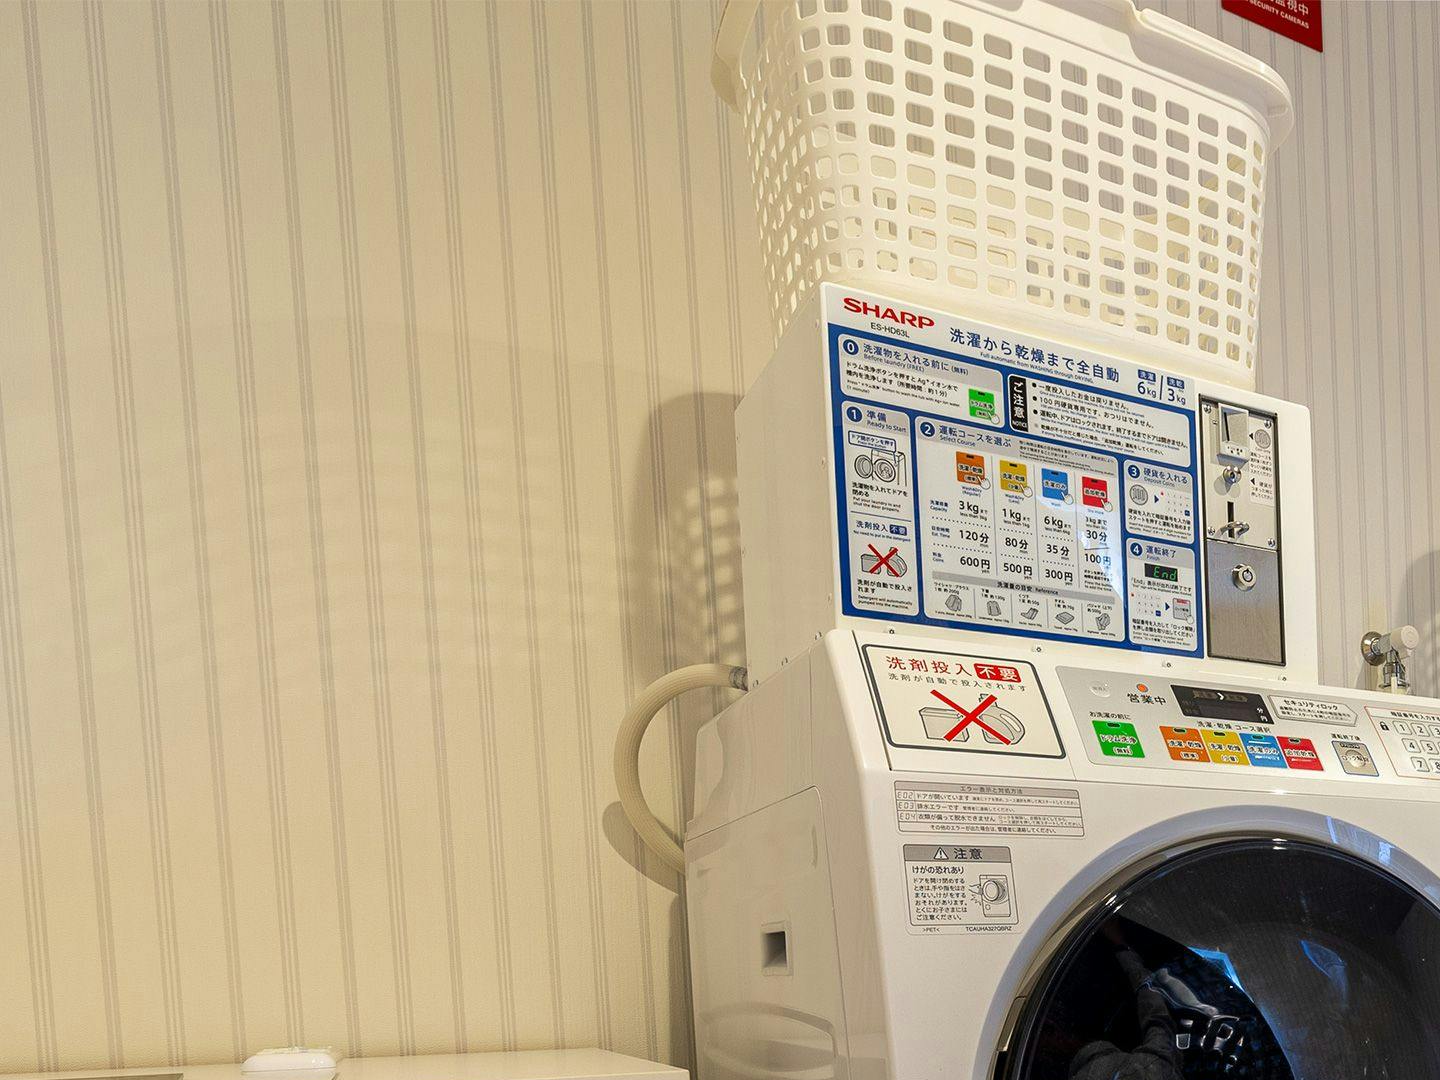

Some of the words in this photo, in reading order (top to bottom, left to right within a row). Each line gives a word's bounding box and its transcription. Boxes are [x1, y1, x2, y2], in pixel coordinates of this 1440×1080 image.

[1280, 11, 1309, 29] CAMERAS
[843, 297, 935, 329] SHARP
[870, 322, 910, 338] ES-HD63L
[863, 343, 950, 371] 洗濯物を入れる前に
[950, 327, 1119, 383] 洗濯から乾燥まで全自動
[1012, 381, 1025, 419] ご注意
[866, 409, 887, 422] 準備
[867, 421, 886, 431] Ready
[939, 424, 1012, 448] 運転コースを選ぶ
[940, 434, 957, 444] Select
[957, 438, 976, 448] Course
[1143, 467, 1188, 484] 硬貨を入れる
[856, 520, 888, 533] 洗剤投入
[959, 529, 989, 543] 120分
[1086, 530, 1107, 542] 30分
[1005, 537, 1029, 550] 80分
[1046, 544, 1070, 556] 35分
[1146, 545, 1176, 558] 運転終了
[960, 556, 990, 570] 600円
[1084, 553, 1111, 566] 100円
[1003, 563, 1032, 576] 500円
[1045, 569, 1073, 582] 300円
[1153, 566, 1177, 580] End
[886, 655, 972, 677] 洗剤投入
[977, 665, 1018, 681] 不要
[888, 672, 1027, 692] 洗剤が自動で投入されます
[1127, 693, 1166, 705] 営業中
[1284, 699, 1338, 711] セキュリティロック
[897, 791, 914, 800] E02
[898, 802, 914, 810] E03
[954, 847, 983, 860] 注意
[911, 865, 964, 875] けがの恐れあり
